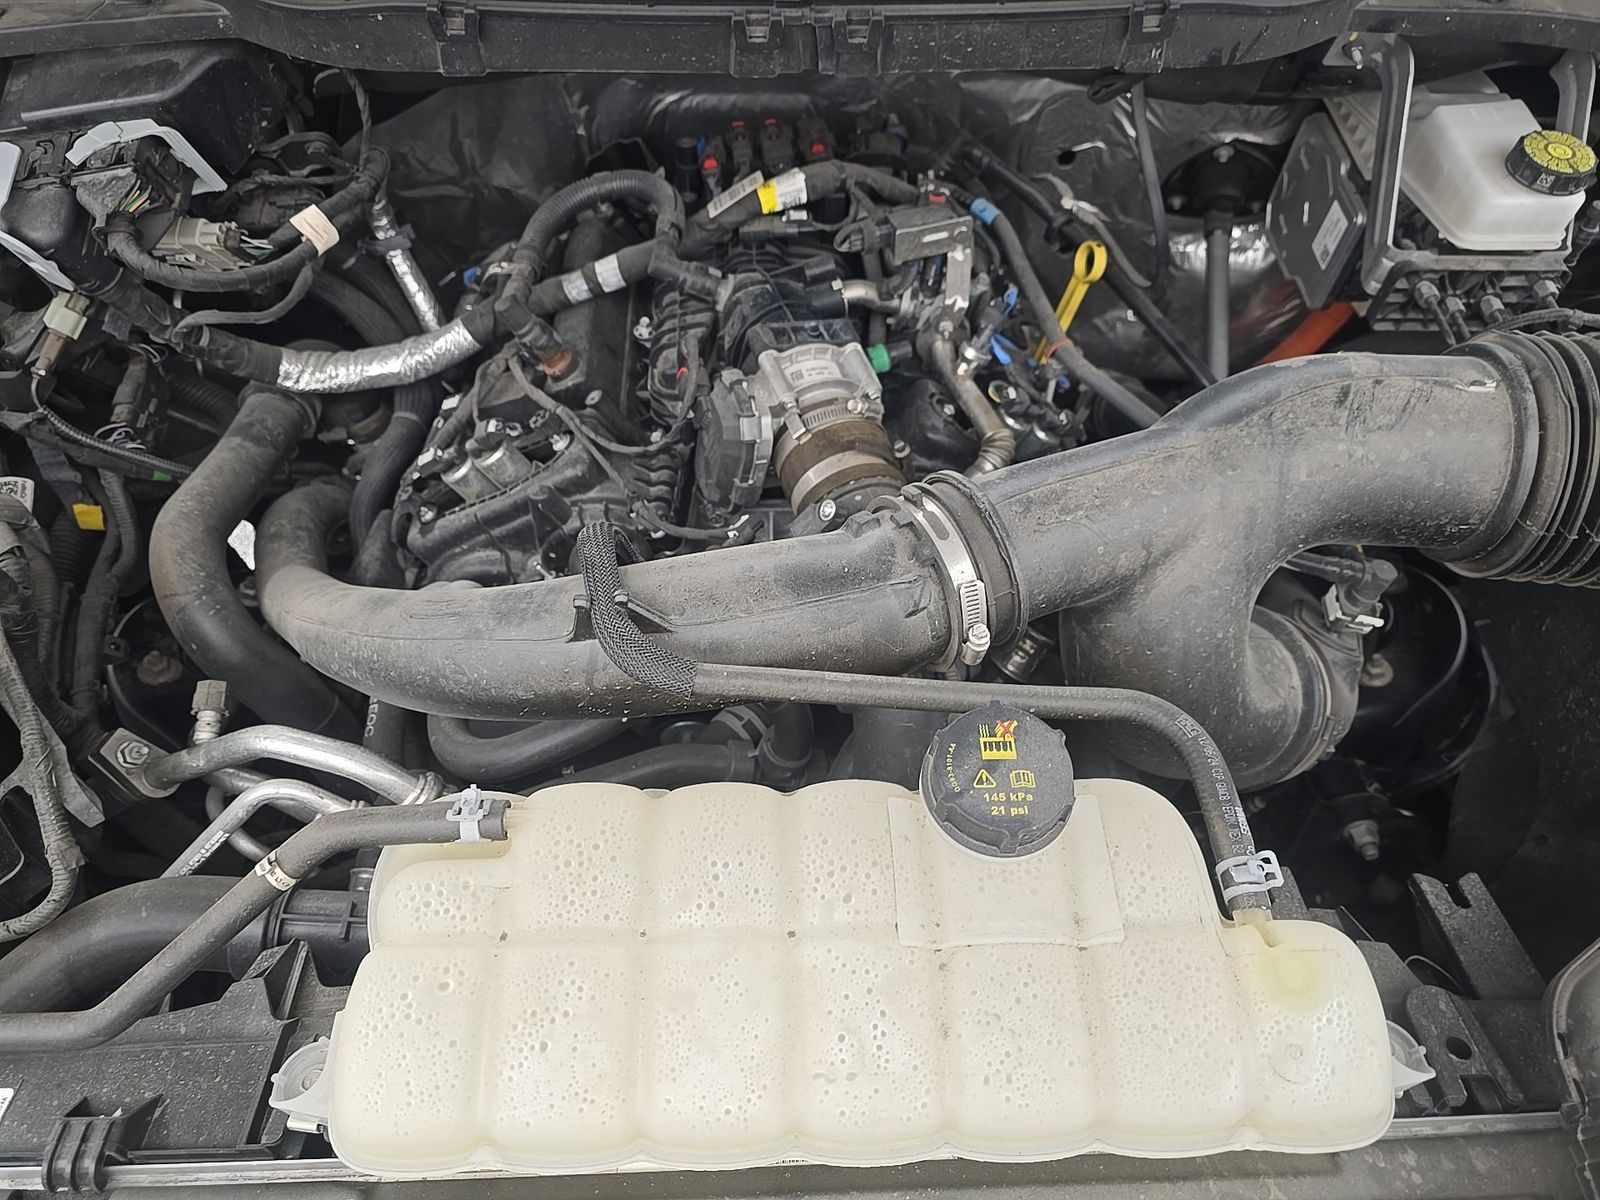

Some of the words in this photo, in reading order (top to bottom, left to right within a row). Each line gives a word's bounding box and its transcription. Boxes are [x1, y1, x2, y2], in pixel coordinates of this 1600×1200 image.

[983, 792, 1007, 802] 145
[1010, 792, 1034, 802] kPa
[991, 805, 1006, 816] 21
[1010, 805, 1029, 817] psi
